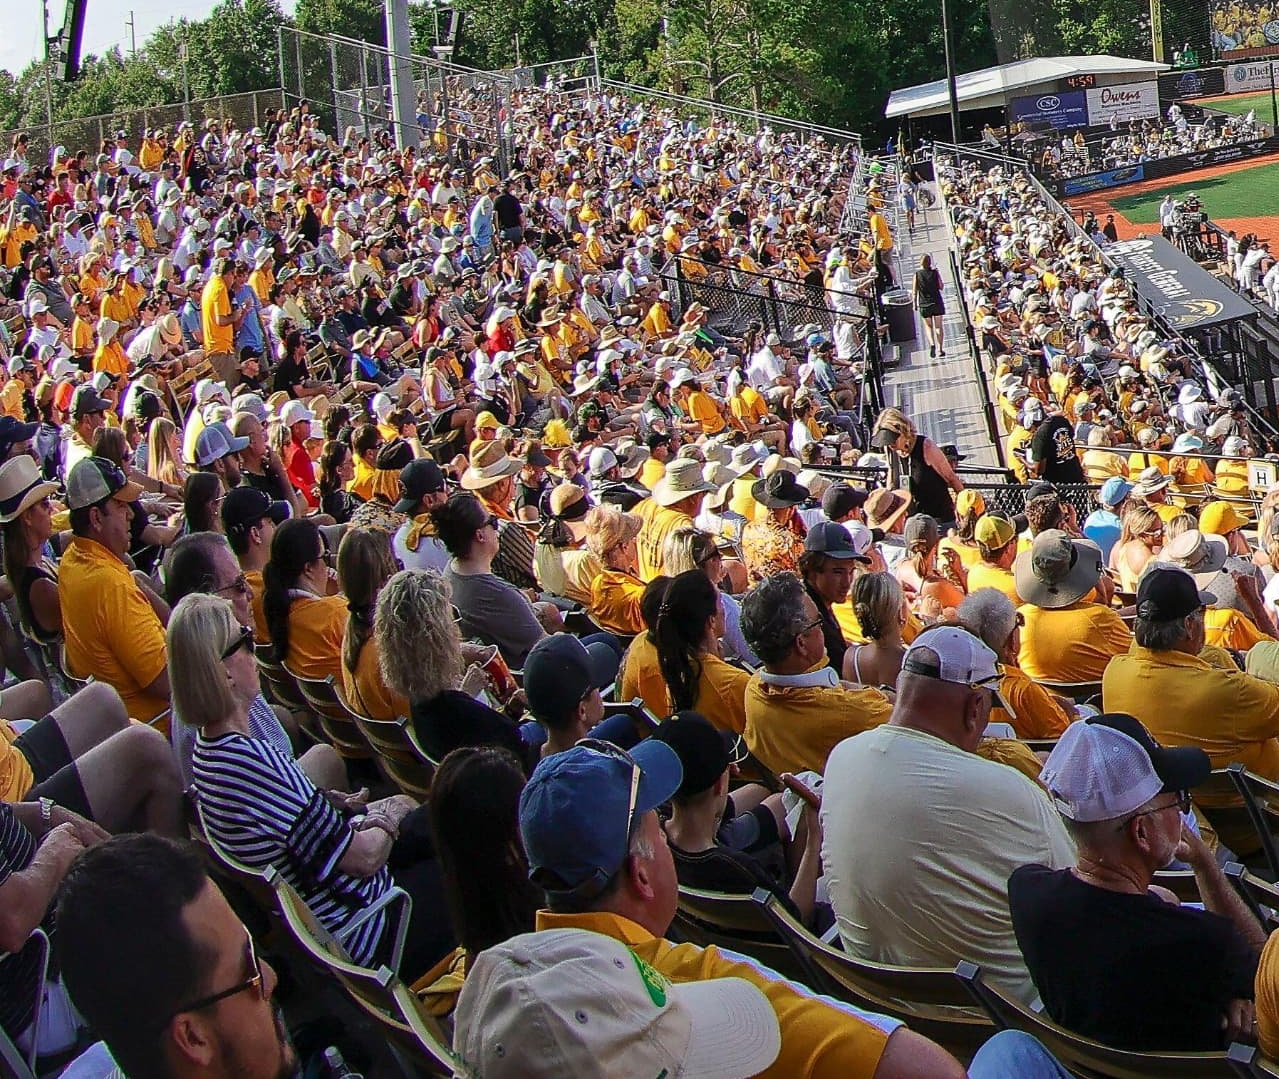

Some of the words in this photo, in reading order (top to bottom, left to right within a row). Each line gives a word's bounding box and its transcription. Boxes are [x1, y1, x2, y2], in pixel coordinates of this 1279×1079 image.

[1067, 75, 1094, 88] 4:59
[1101, 88, 1141, 103] Owens
[1039, 99, 1057, 108] CSC
[1257, 472, 1266, 485] H
